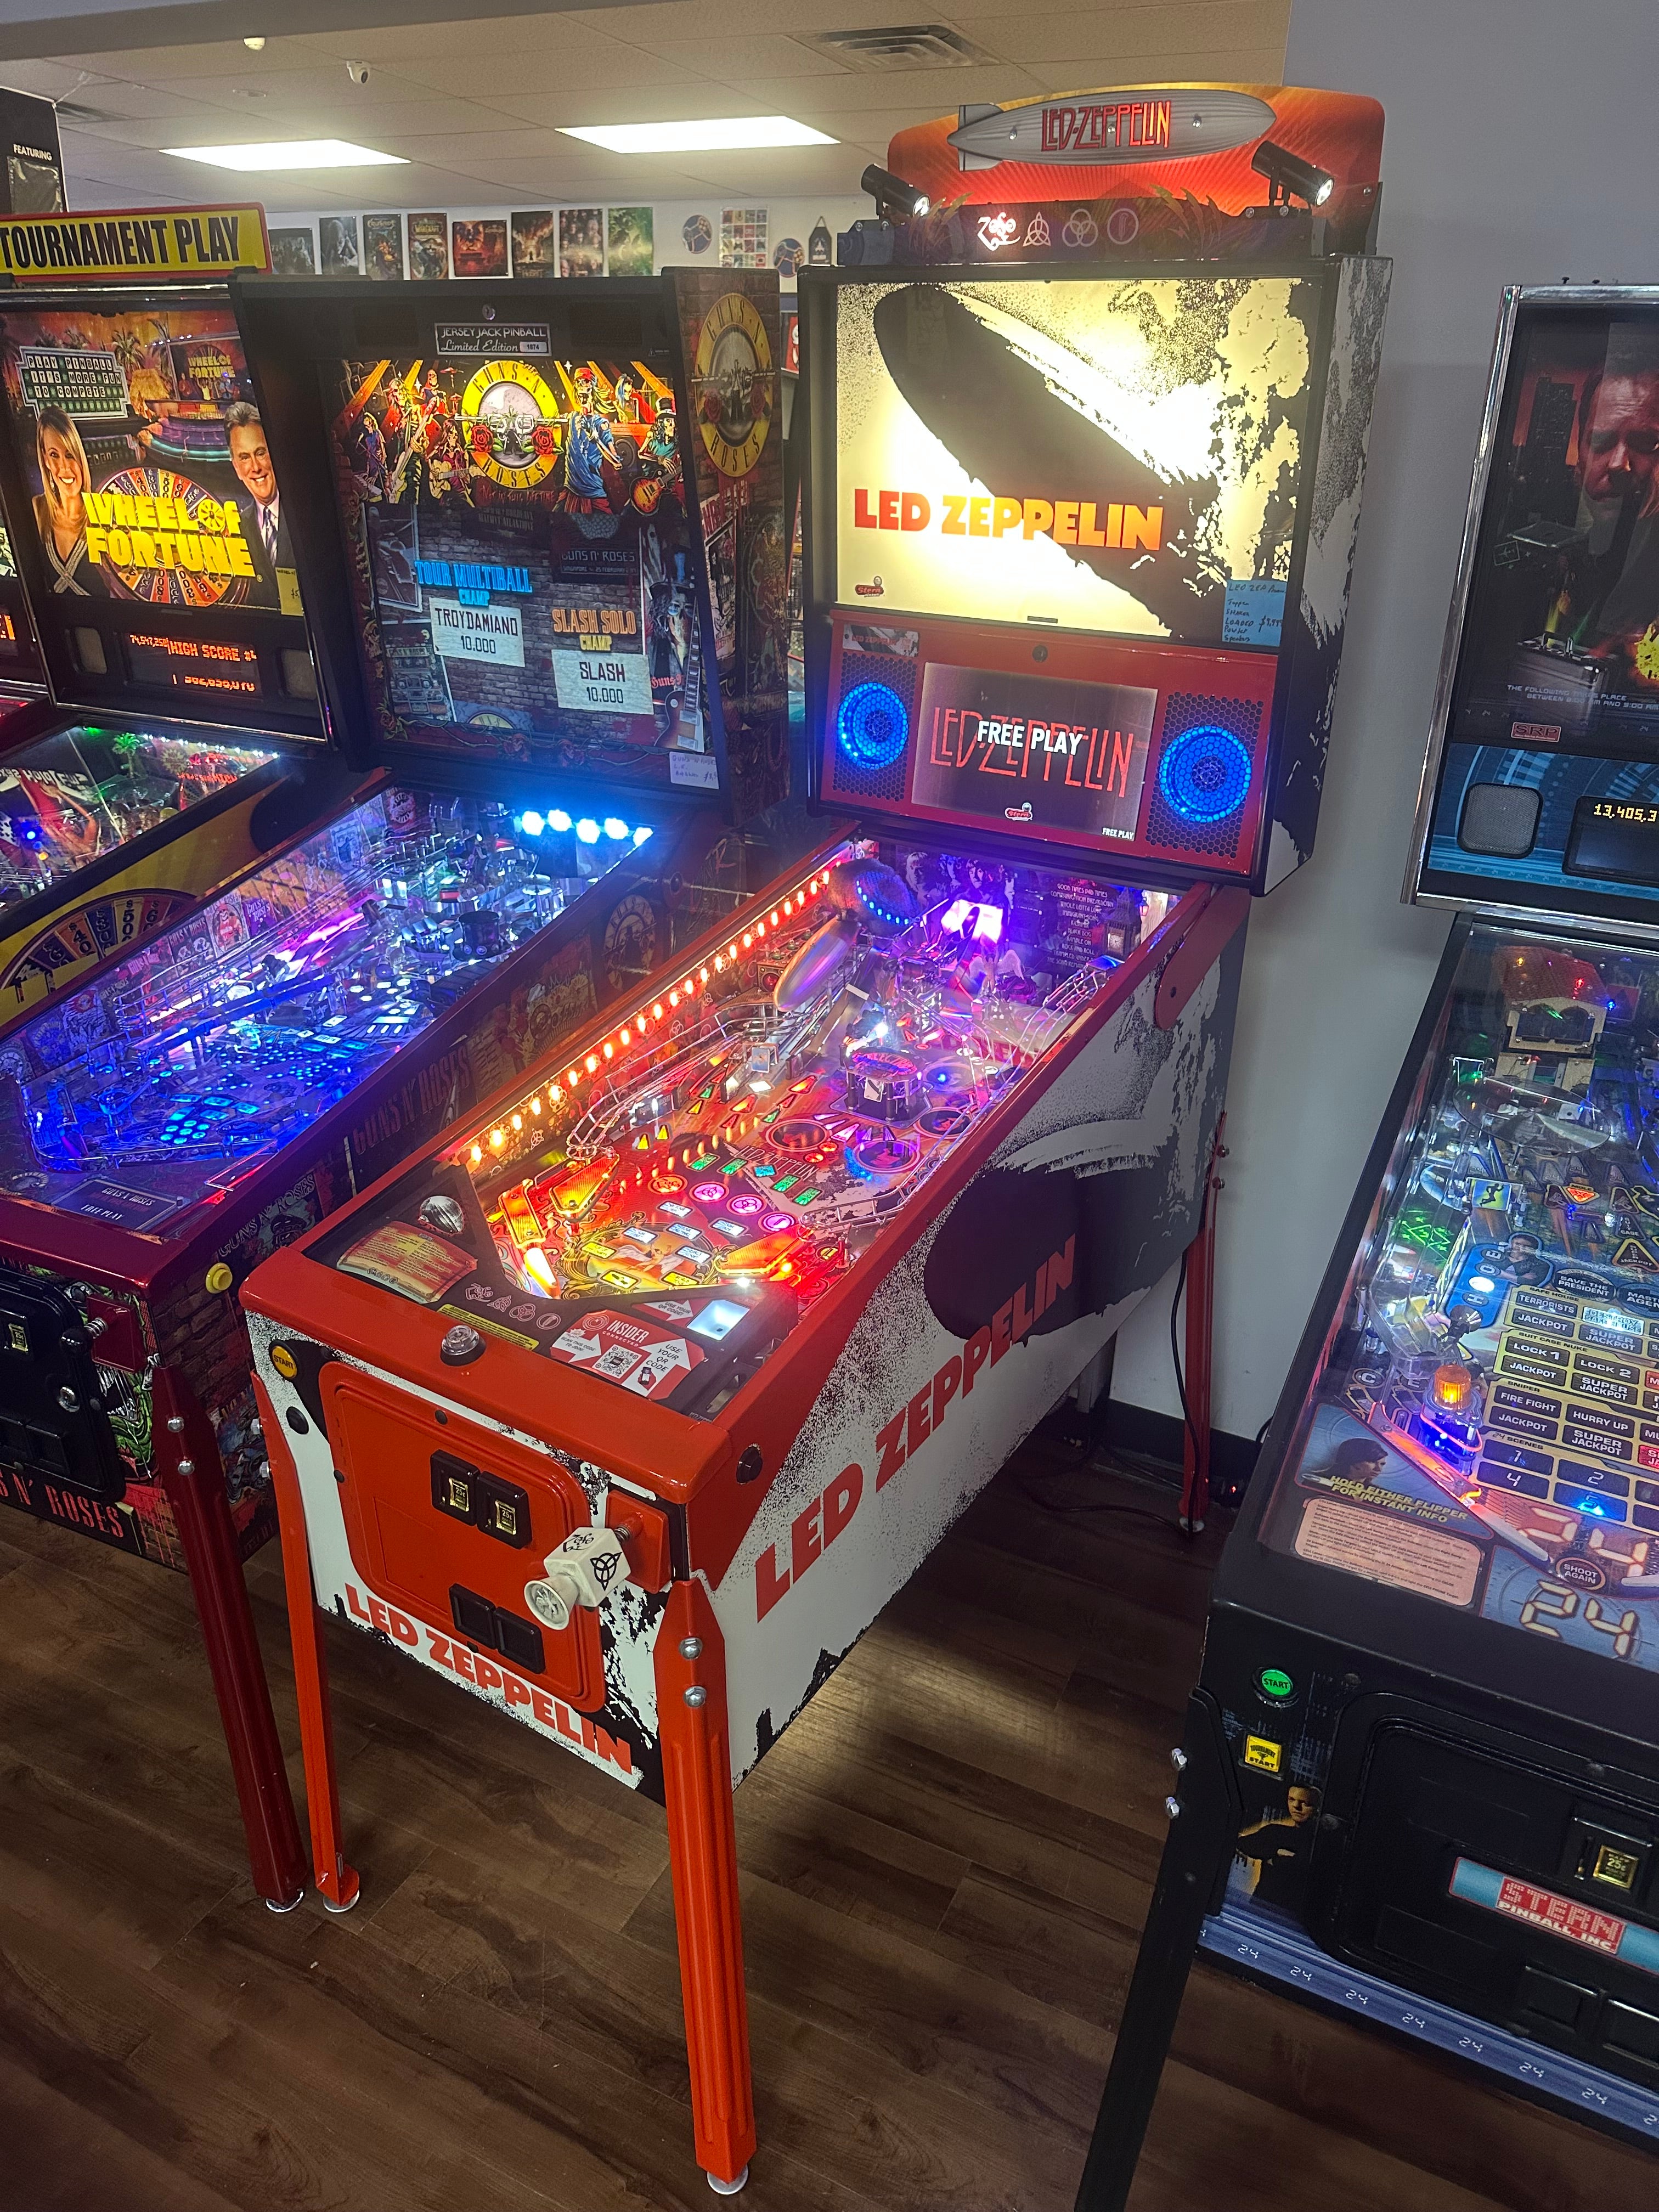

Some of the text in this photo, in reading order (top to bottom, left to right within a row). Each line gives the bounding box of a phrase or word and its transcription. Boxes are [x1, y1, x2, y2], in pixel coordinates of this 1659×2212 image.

[13, 144, 52, 161] FEATURING
[0, 216, 240, 268] TOURNAMENT PLAY
[441, 328, 546, 338] JERSEY JACK PINBALL
[441, 338, 518, 352] Limited Edition
[29, 358, 112, 370] PLAY PINBALL
[188, 356, 220, 367] WHEEL
[70, 374, 97, 383] MORE
[103, 375, 121, 383] FUN
[189, 366, 235, 379] FORTUNE
[472, 362, 518, 393] GUNS
[36, 387, 105, 397] TO COMPETE
[482, 458, 546, 488] ROSES
[82, 493, 200, 531] WHEEL
[854, 488, 1164, 551] LED ZEPPELIN
[86, 527, 256, 578] FORTUNE
[603, 551, 635, 562] ROSES
[414, 561, 533, 593] TOUR MULTIBALL
[459, 588, 490, 606] CHAMP
[435, 608, 518, 636] TROYDAMIANO
[552, 609, 637, 635] SLASH SOLO
[170, 640, 199, 657] HIGH
[201, 644, 241, 662] SCORE
[579, 635, 612, 651] CHAMP
[579, 661, 626, 682] SLASH
[1525, 686, 1570, 697] FOLLOWING
[1601, 693, 1627, 702] PLACE
[1527, 693, 1564, 702] BETWEEN
[977, 720, 1083, 755] FREE PLAY
[1515, 724, 1558, 737] SRP
[1102, 827, 1135, 840] FREE PLAY
[1057, 883, 1070, 891] GOOD
[1076, 903, 1091, 912] LOTTA
[1084, 947, 1095, 956] ROLL
[81, 1204, 125, 1221] FREE PLAY
[218, 1173, 316, 1257] GUNS ROSES
[1620, 1259, 1653, 1267] JACKPOT
[1558, 1279, 1610, 1297] PRESIDENT
[1560, 1276, 1609, 1290] SAVE THE
[1530, 1287, 1580, 1302] SAFE HOUSE
[1519, 1294, 1575, 1313] TERRORISTS
[1517, 1314, 1568, 1331] JACKPOT
[1589, 1309, 1638, 1325] DESTROY
[602, 1330, 639, 1347] CONNECTED
[606, 1319, 650, 1344] INSIDER
[1590, 1329, 1634, 1344] SUPER
[664, 1344, 684, 1354] USE
[1519, 1332, 1589, 1352] SUIT CASE NUKE
[1585, 1334, 1635, 1351] JACKPOT
[656, 1356, 669, 1364] QR
[657, 1347, 680, 1361] YOUR
[1513, 1342, 1560, 1361] LOCK 1
[274, 1354, 294, 1370] START
[646, 1359, 669, 1373] CODE
[1510, 1362, 1557, 1379] JACKPOT
[1581, 1359, 1632, 1379] LOCK 2
[1508, 1381, 1541, 1393] SNIPER
[1579, 1383, 1628, 1401] JACKPOT
[1582, 1377, 1628, 1395] SUPER
[1500, 1392, 1556, 1413] FIRE FIGHT
[755, 1233, 1076, 1623] LED ZEPPELIN
[1498, 1414, 1548, 1432] JACKPOT
[1573, 1411, 1628, 1431] HURRY UP
[1506, 1436, 1544, 1450] SCENES
[1572, 1436, 1622, 1456] JACKPOT
[1573, 1430, 1622, 1448] SUPER
[1506, 1472, 1521, 1487] 4
[1587, 1471, 1604, 1485] 2
[1330, 1475, 1469, 1520] HOLD EITHER FLIPPER
[1331, 1484, 1449, 1523] FOR INSTANT INFO
[44, 1483, 124, 1538] ROSES
[1564, 1563, 1598, 1578] SHOOT
[1564, 1570, 1596, 1584] AGAIN
[1520, 1579, 1639, 1657] 24
[345, 1582, 634, 1775] LED ZEPPELIN
[1263, 1678, 1289, 1690] START
[1249, 1757, 1276, 1768] START
[1503, 1882, 1618, 1942] STERN
[1238, 1944, 1259, 1959] 24
[1290, 1966, 1312, 1981] 24
[1345, 1989, 1368, 2005] 24
[1402, 2012, 1425, 2028] 24
[1459, 2036, 1483, 2052] 24
[1519, 2062, 1544, 2078] 24
[1582, 2087, 1608, 2106] 24
